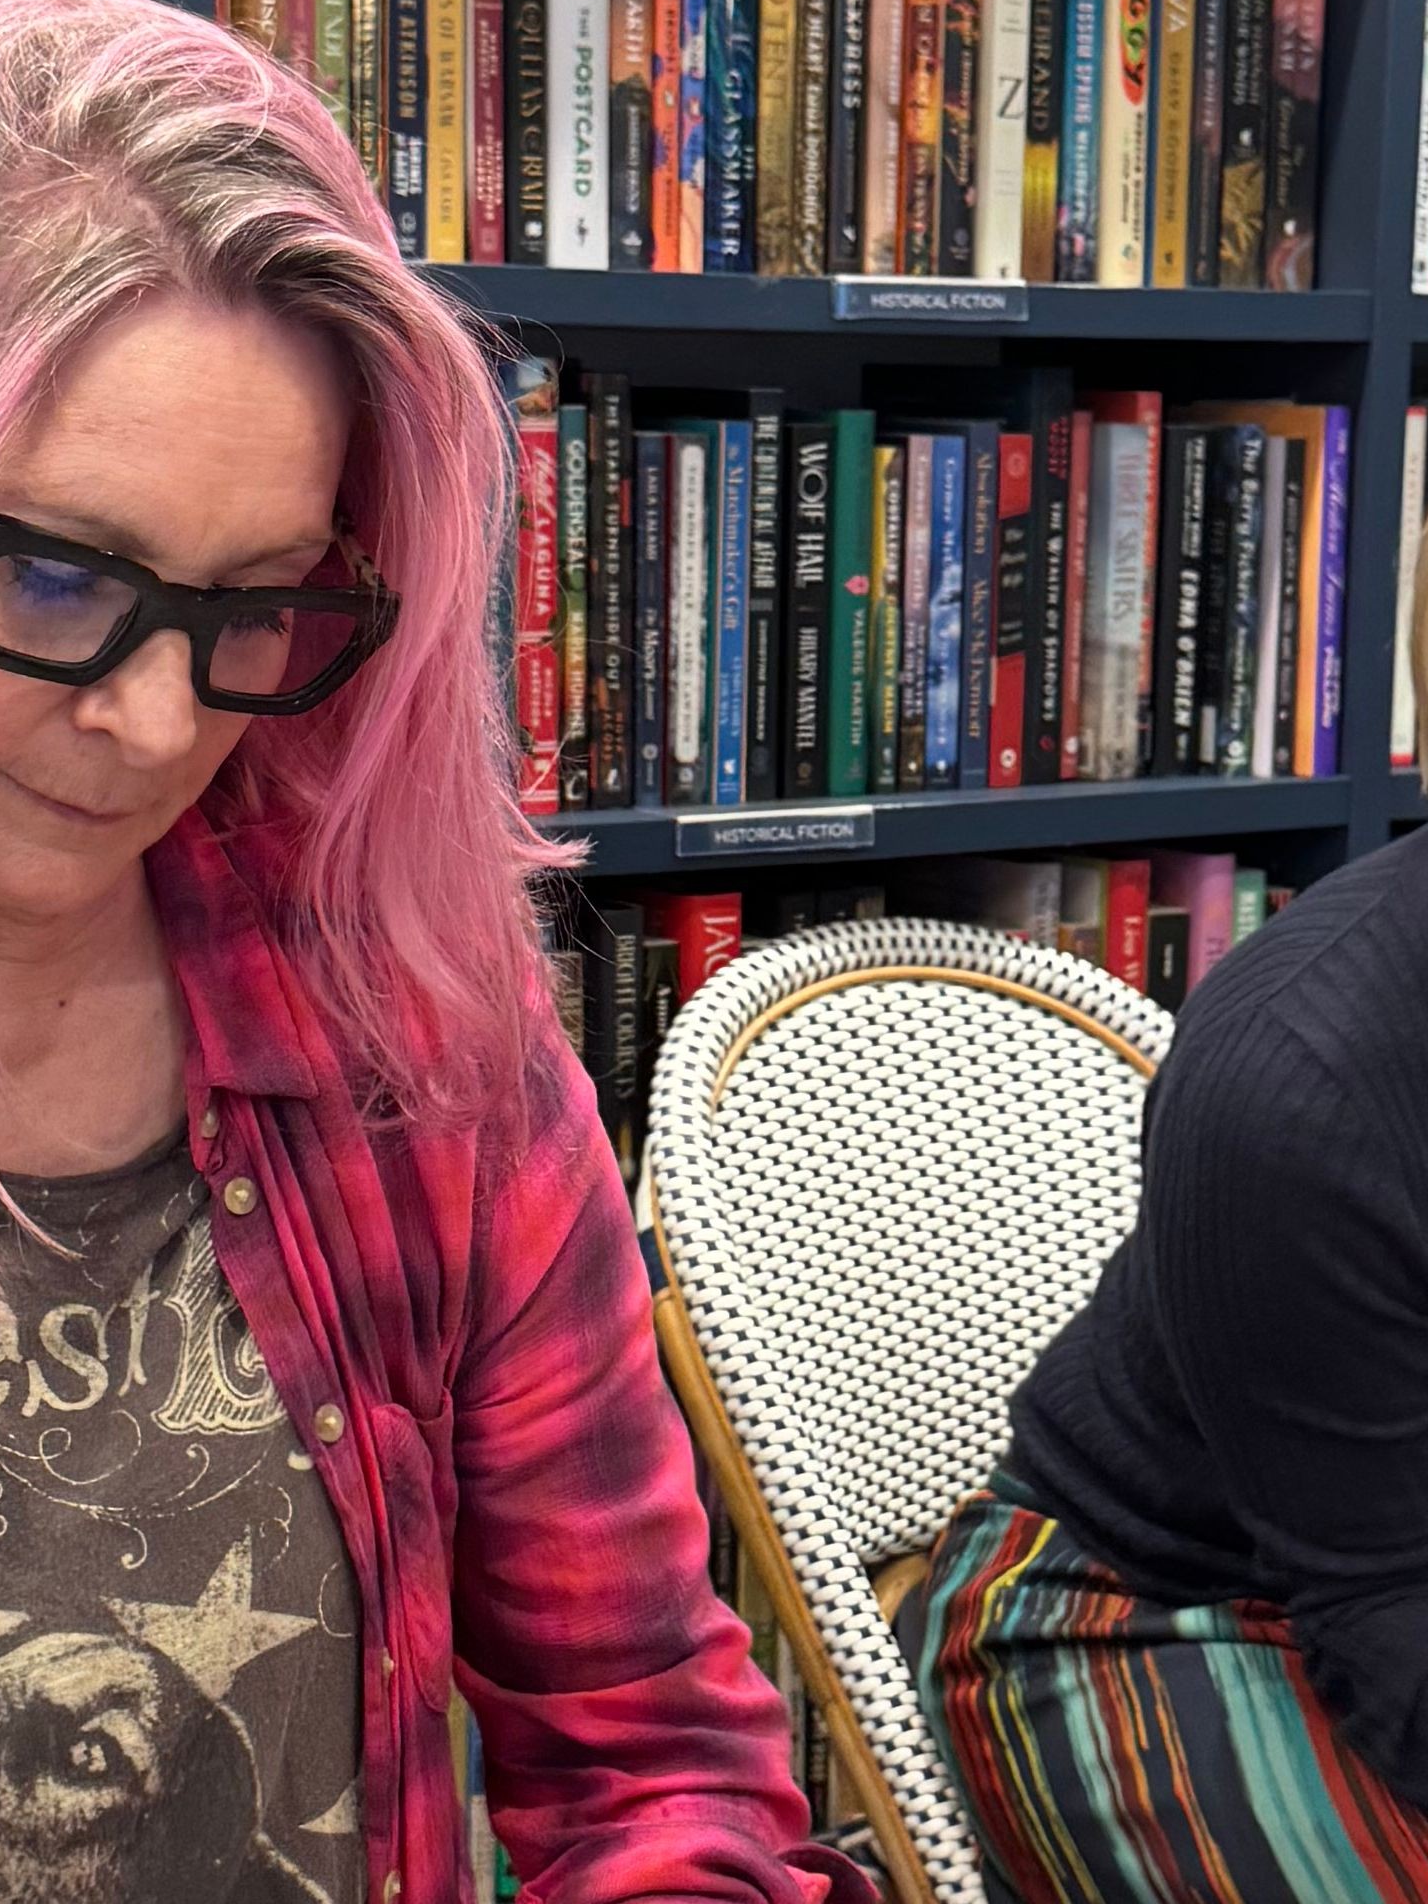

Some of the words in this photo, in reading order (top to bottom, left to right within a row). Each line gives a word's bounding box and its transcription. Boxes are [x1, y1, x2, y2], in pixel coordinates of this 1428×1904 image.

[572, 47, 593, 198] POSTCARD
[950, 294, 1006, 309] FICTION
[797, 441, 827, 524] WOLF
[795, 527, 824, 590] HALL
[714, 826, 794, 843] HISTORICAL
[797, 823, 854, 839] FICTION
